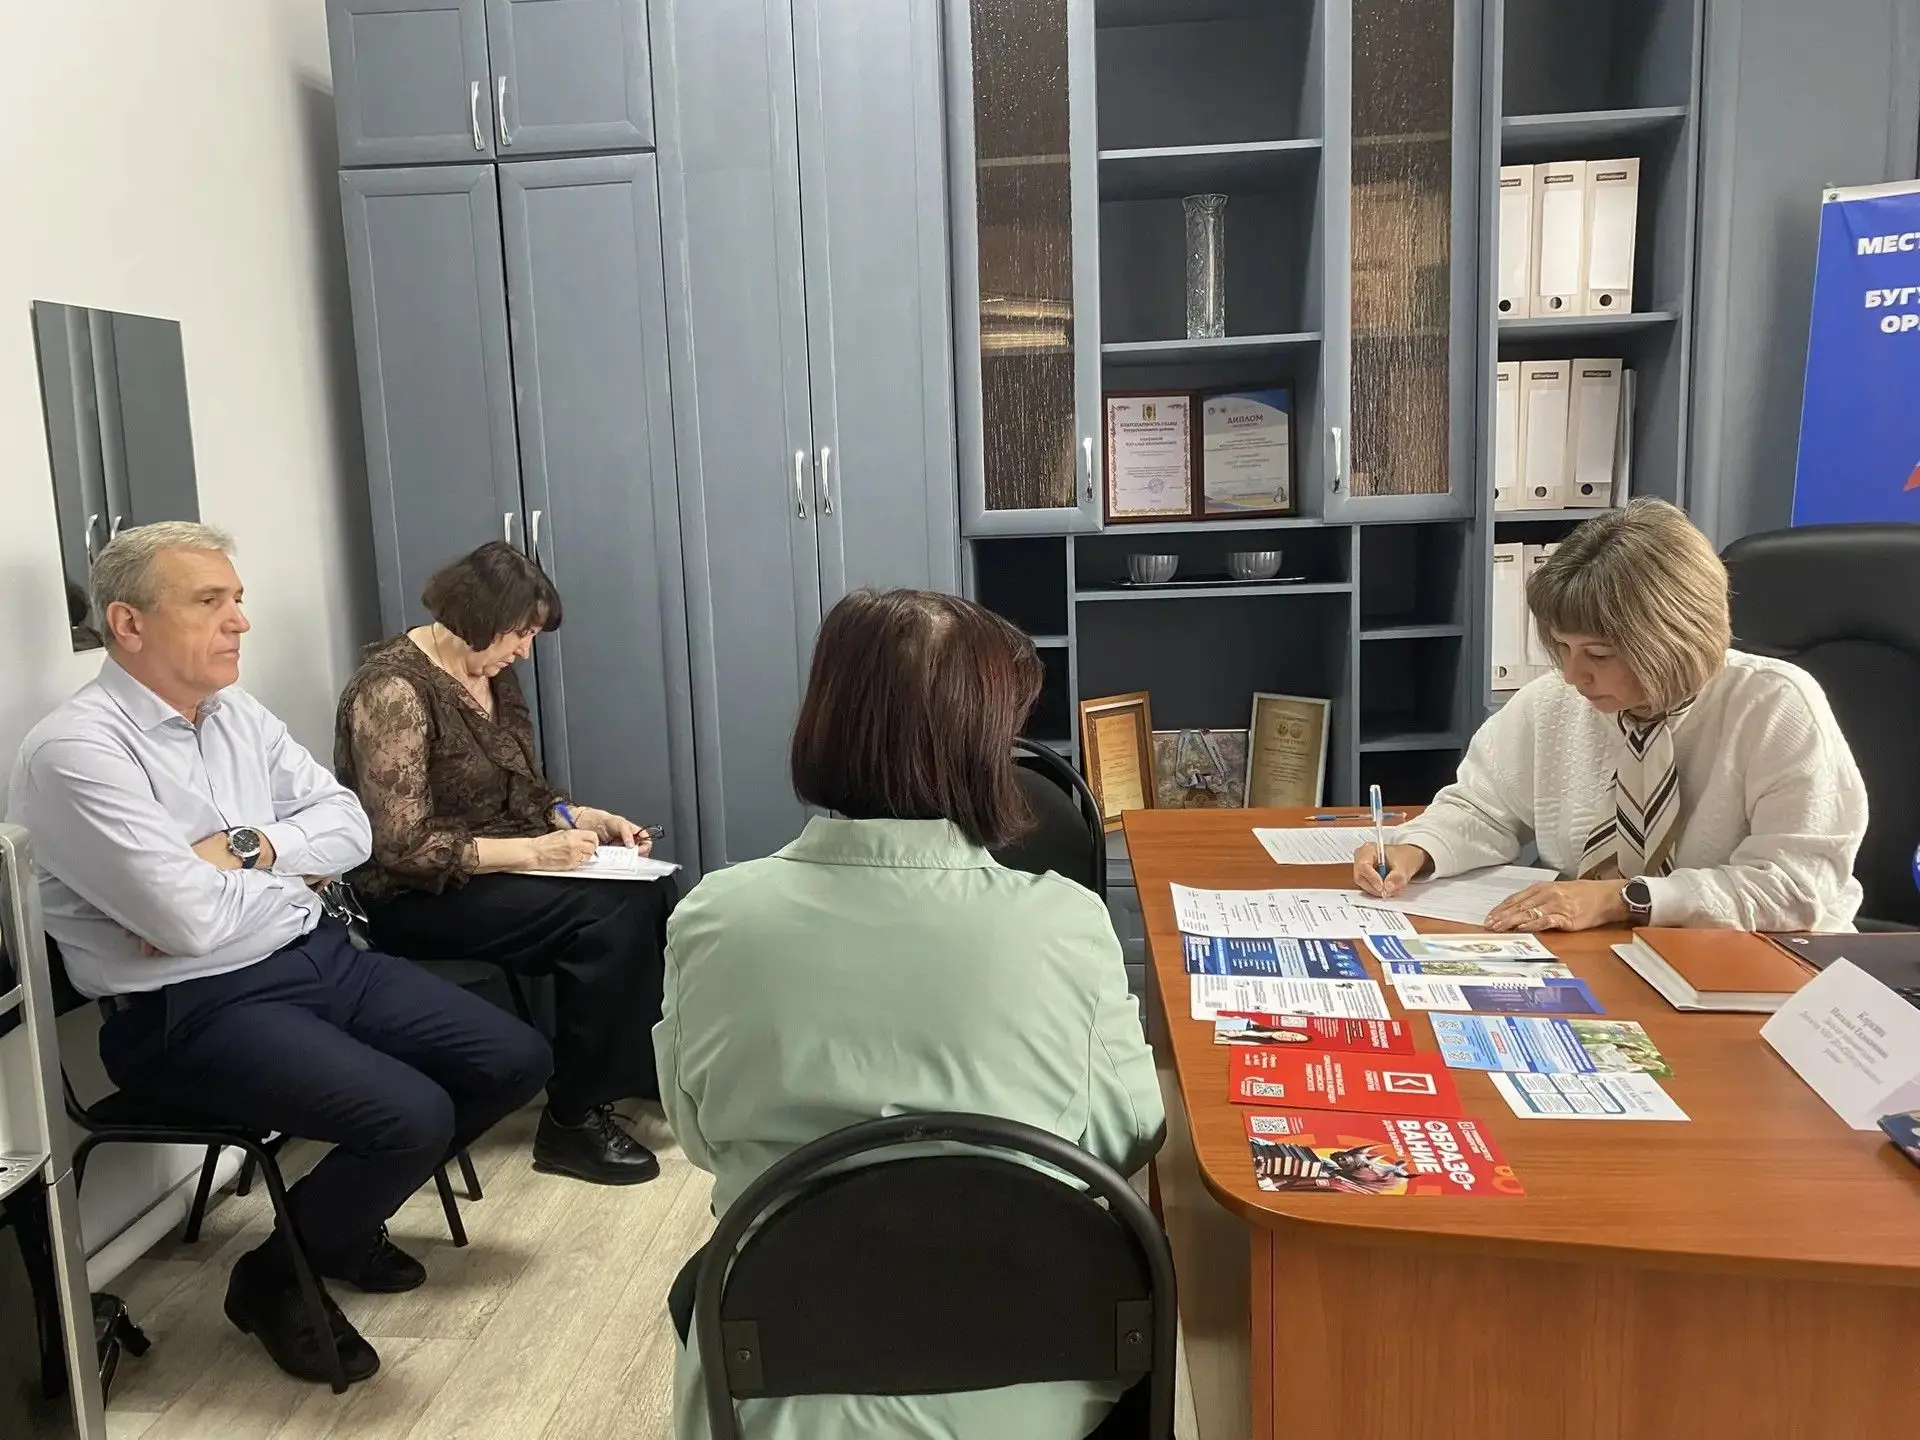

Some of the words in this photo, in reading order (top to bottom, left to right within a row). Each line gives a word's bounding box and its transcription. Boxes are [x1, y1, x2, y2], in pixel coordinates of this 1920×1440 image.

[1881, 313, 1920, 334] ОР
[1227, 415, 1264, 425] ДИПЛОМ
[1396, 1120, 1443, 1173] ВАНИЕ
[1423, 1120, 1476, 1190] ОБРАЗО-
